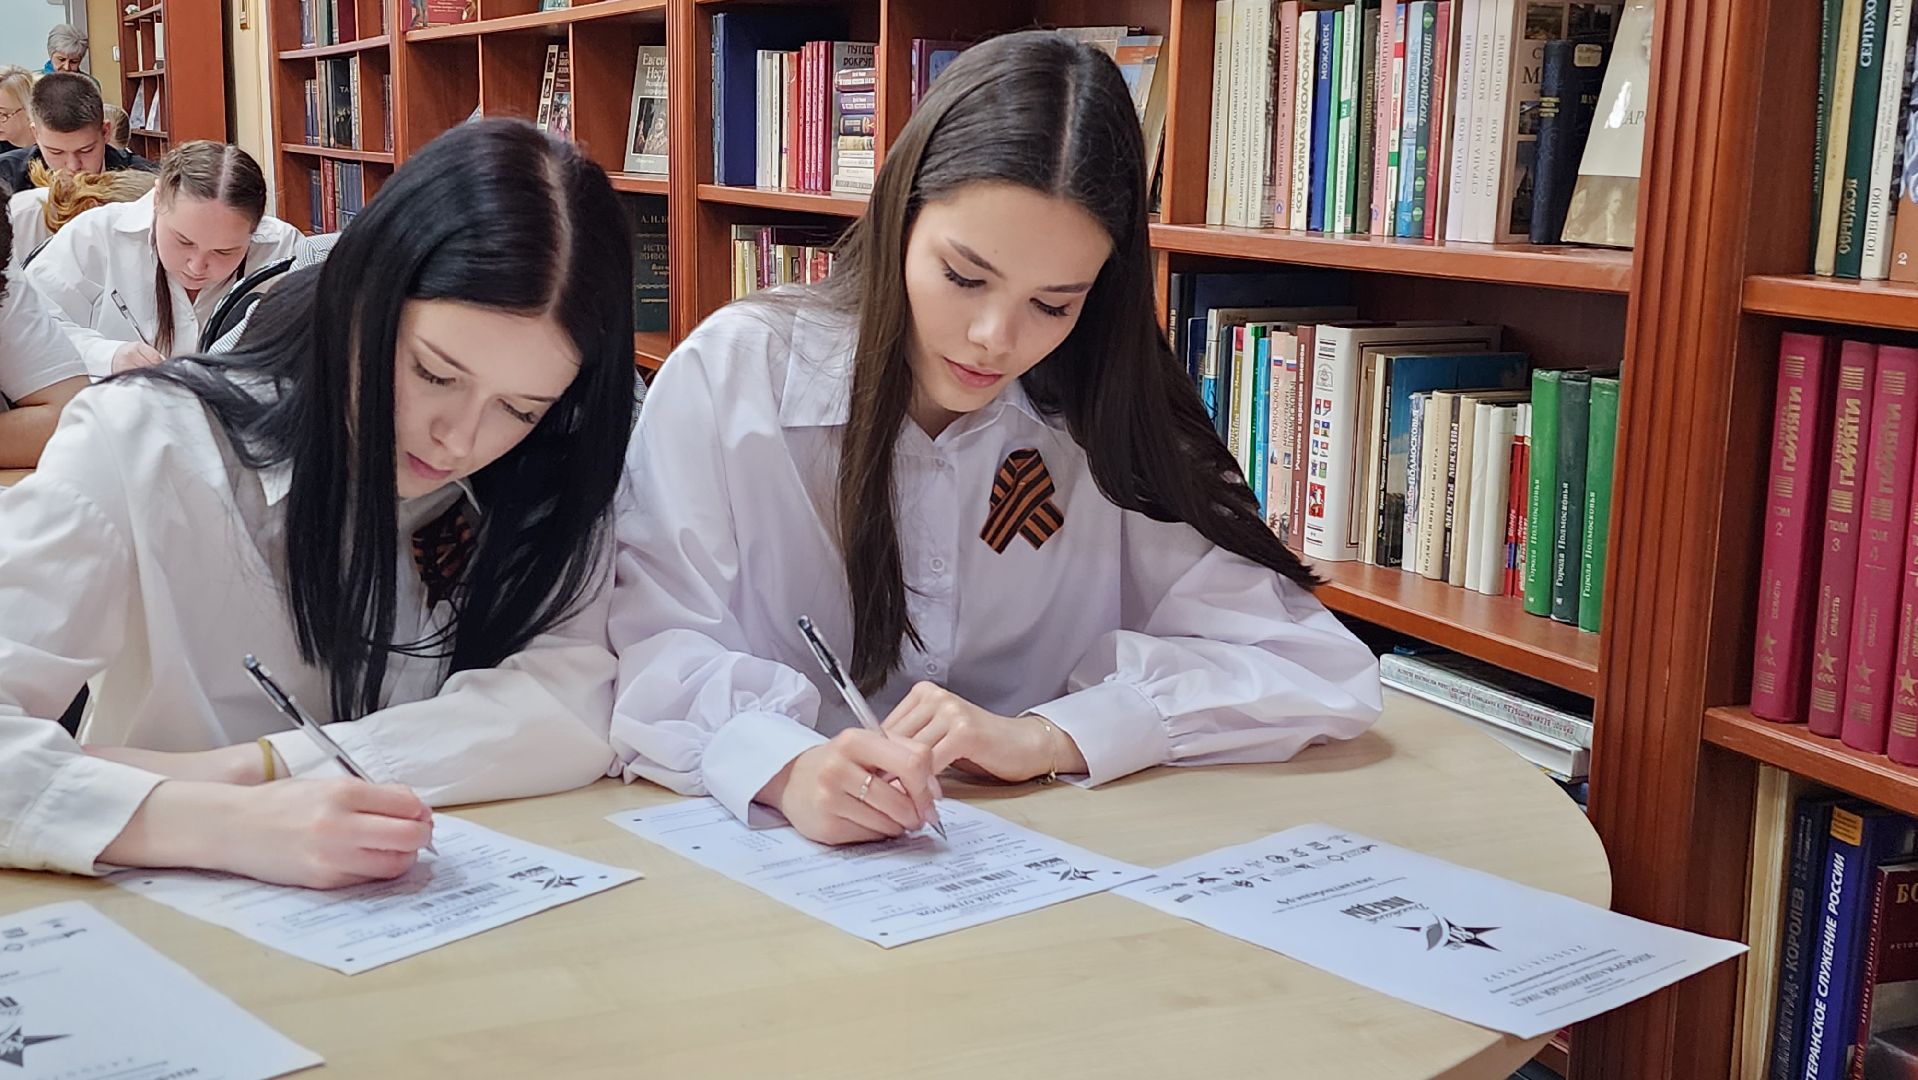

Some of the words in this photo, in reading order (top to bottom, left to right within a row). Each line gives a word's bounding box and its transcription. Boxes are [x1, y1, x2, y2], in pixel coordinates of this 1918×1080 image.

[1320, 23, 1330, 79] МОЖАЙСК
[1460, 33, 1472, 100] МОСКОВИЯ
[1477, 31, 1489, 100] МОСКОВИЯ
[1493, 33, 1505, 102] МОСКОВИЯ
[1457, 116, 1466, 142] МОЯ
[1474, 116, 1483, 141] МОЯ
[1489, 118, 1498, 144] МОЯ
[1294, 127, 1306, 213] KOLOMNA
[1453, 146, 1464, 194] СТРАНА
[1470, 147, 1481, 195] СТРАНА
[1485, 149, 1496, 197] СТРАНА
[1864, 186, 1882, 258] ПОЛЕНОВО
[640, 252, 669, 260] ЖИВО
[1897, 252, 1908, 265] 2
[1294, 431, 1303, 470] Учитель
[1447, 422, 1458, 478] МОСКВЫ
[1781, 385, 1803, 472] ПАМЯТИ
[1837, 397, 1862, 486] ПАМЯТИ
[1877, 402, 1902, 494] ПАМЯТИ
[1444, 482, 1454, 528] МОСТЫ
[1529, 478, 1540, 544] Подмосковья
[1556, 482, 1569, 549] Подмосковья
[1584, 491, 1595, 558] Подмосковья
[1828, 520, 1849, 533] ТОМ
[1528, 548, 1537, 582] Города
[1554, 552, 1566, 586] Города
[1832, 538, 1841, 552] 3
[1582, 563, 1593, 597] Города
[1338, 895, 1414, 920] ПОБЕДЫ
[1824, 851, 1848, 916] РОССИИ
[1783, 886, 1807, 972] КОРОЛЕВ
[1813, 914, 1840, 998] СЛУЖЕНИЕ
